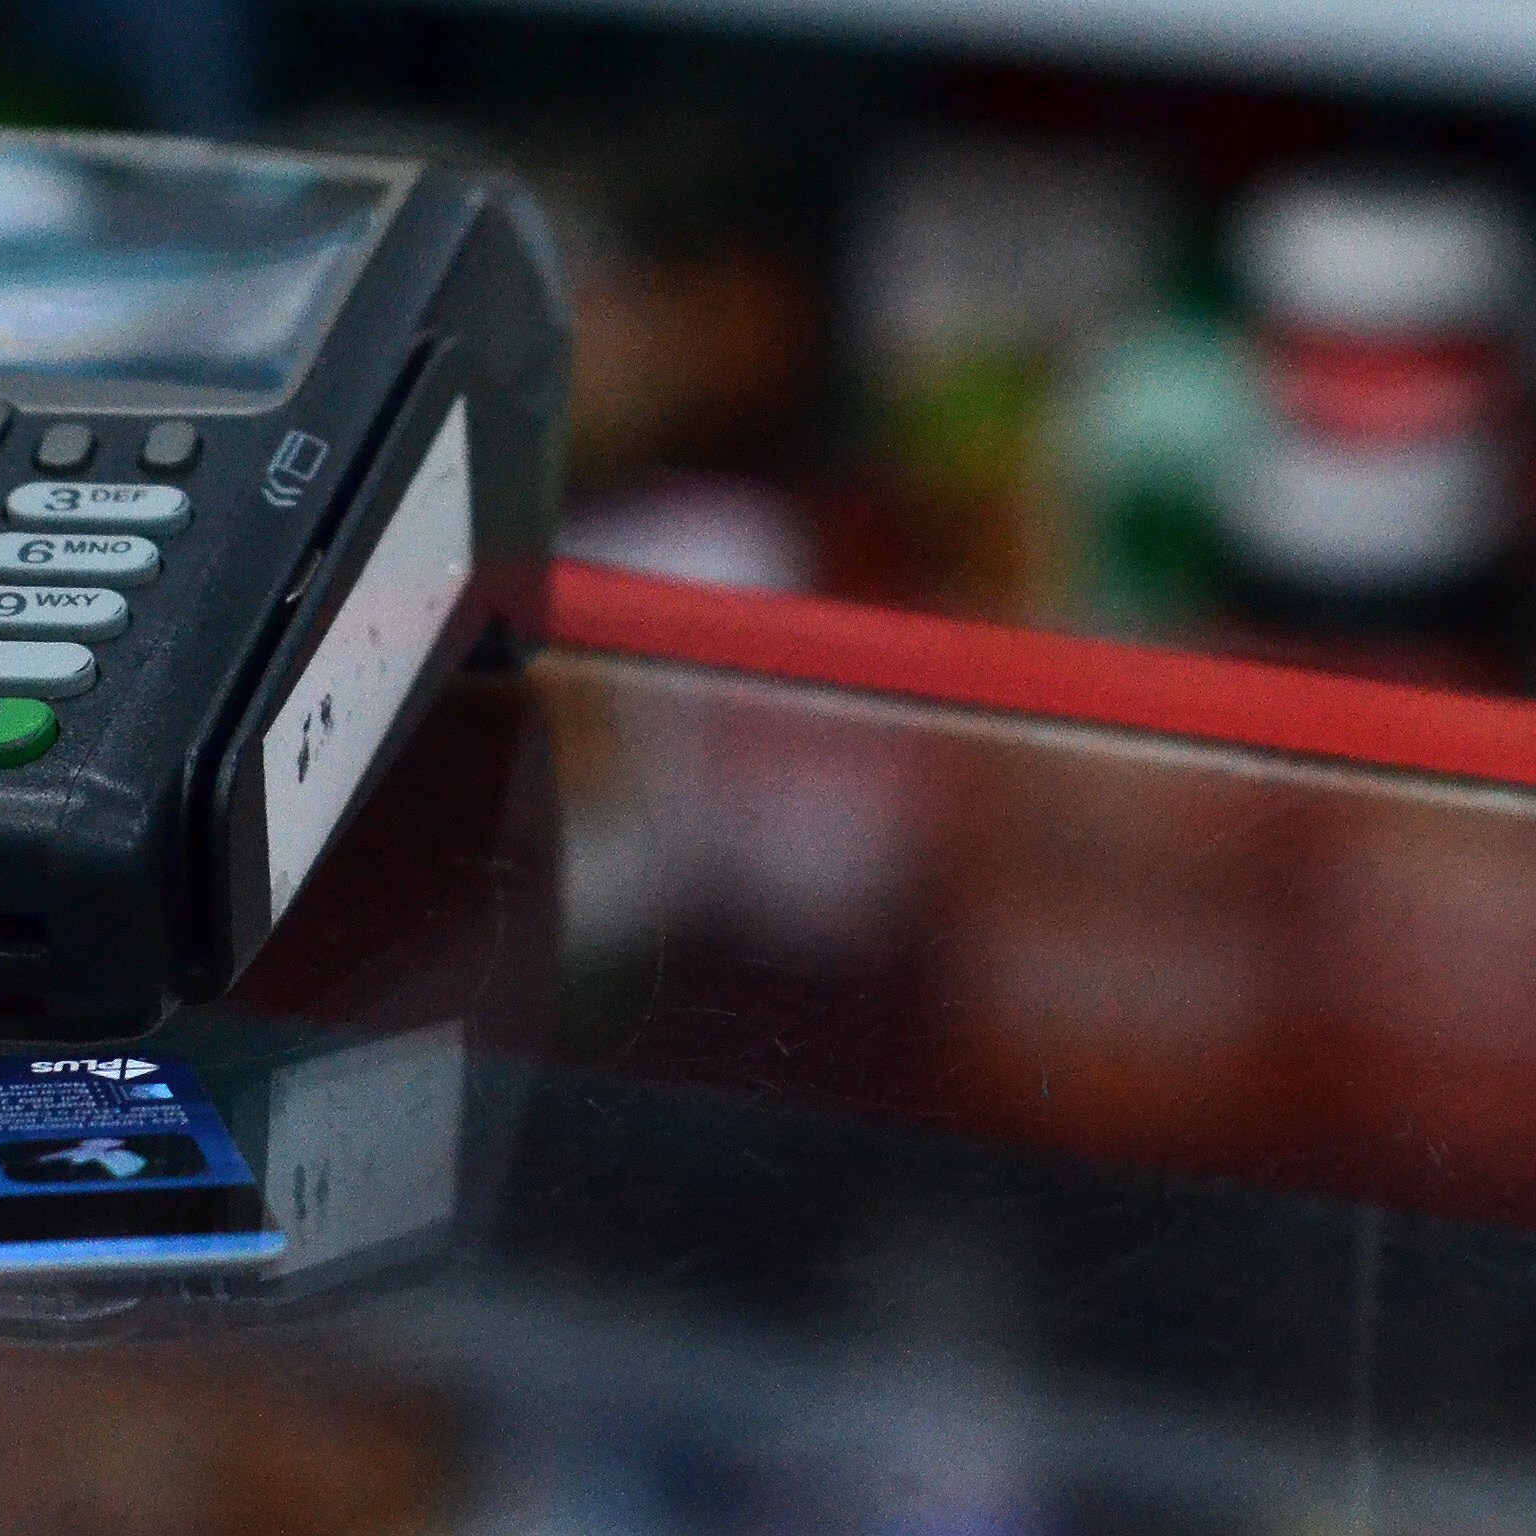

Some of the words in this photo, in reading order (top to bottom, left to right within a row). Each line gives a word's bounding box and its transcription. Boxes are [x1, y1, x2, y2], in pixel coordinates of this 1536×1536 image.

[45, 487, 81, 513] 3
[89, 488, 149, 504] DEF
[17, 539, 55, 565] 6
[64, 541, 133, 555] MNO
[34, 593, 101, 608] WXY
[30, 1058, 122, 1074] PLUS
